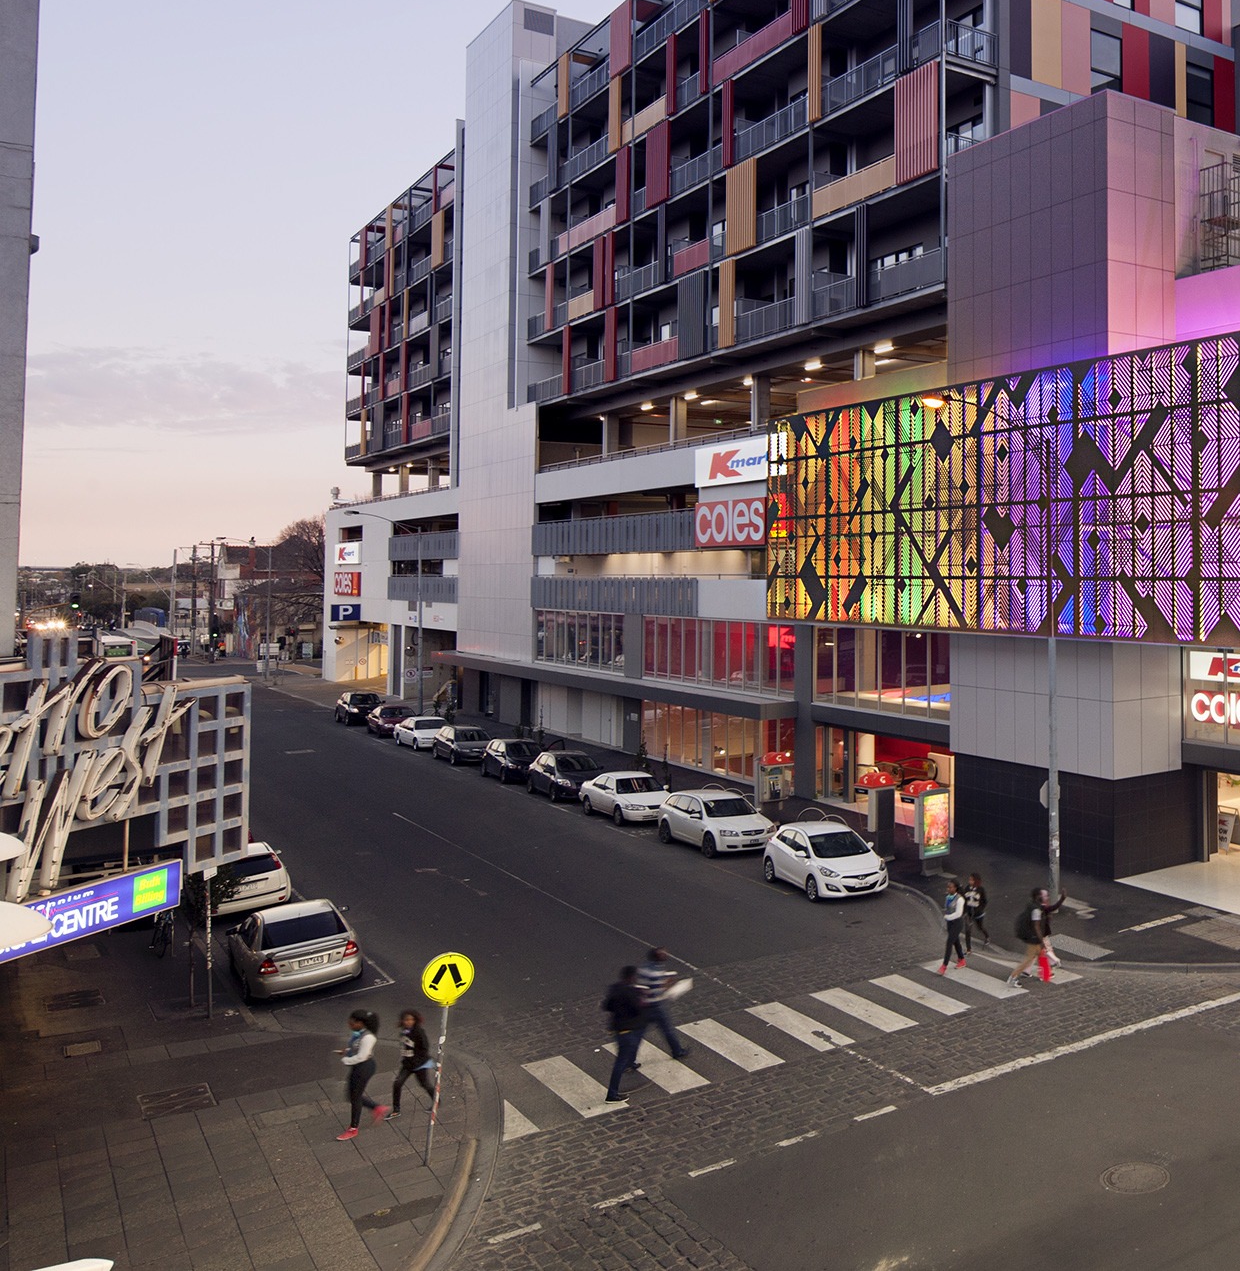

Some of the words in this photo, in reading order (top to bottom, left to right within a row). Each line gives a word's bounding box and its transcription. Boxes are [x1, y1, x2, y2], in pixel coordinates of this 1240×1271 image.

[696, 500, 765, 544] coles
[339, 605, 354, 620] P
[50, 896, 120, 938] CENTRE
